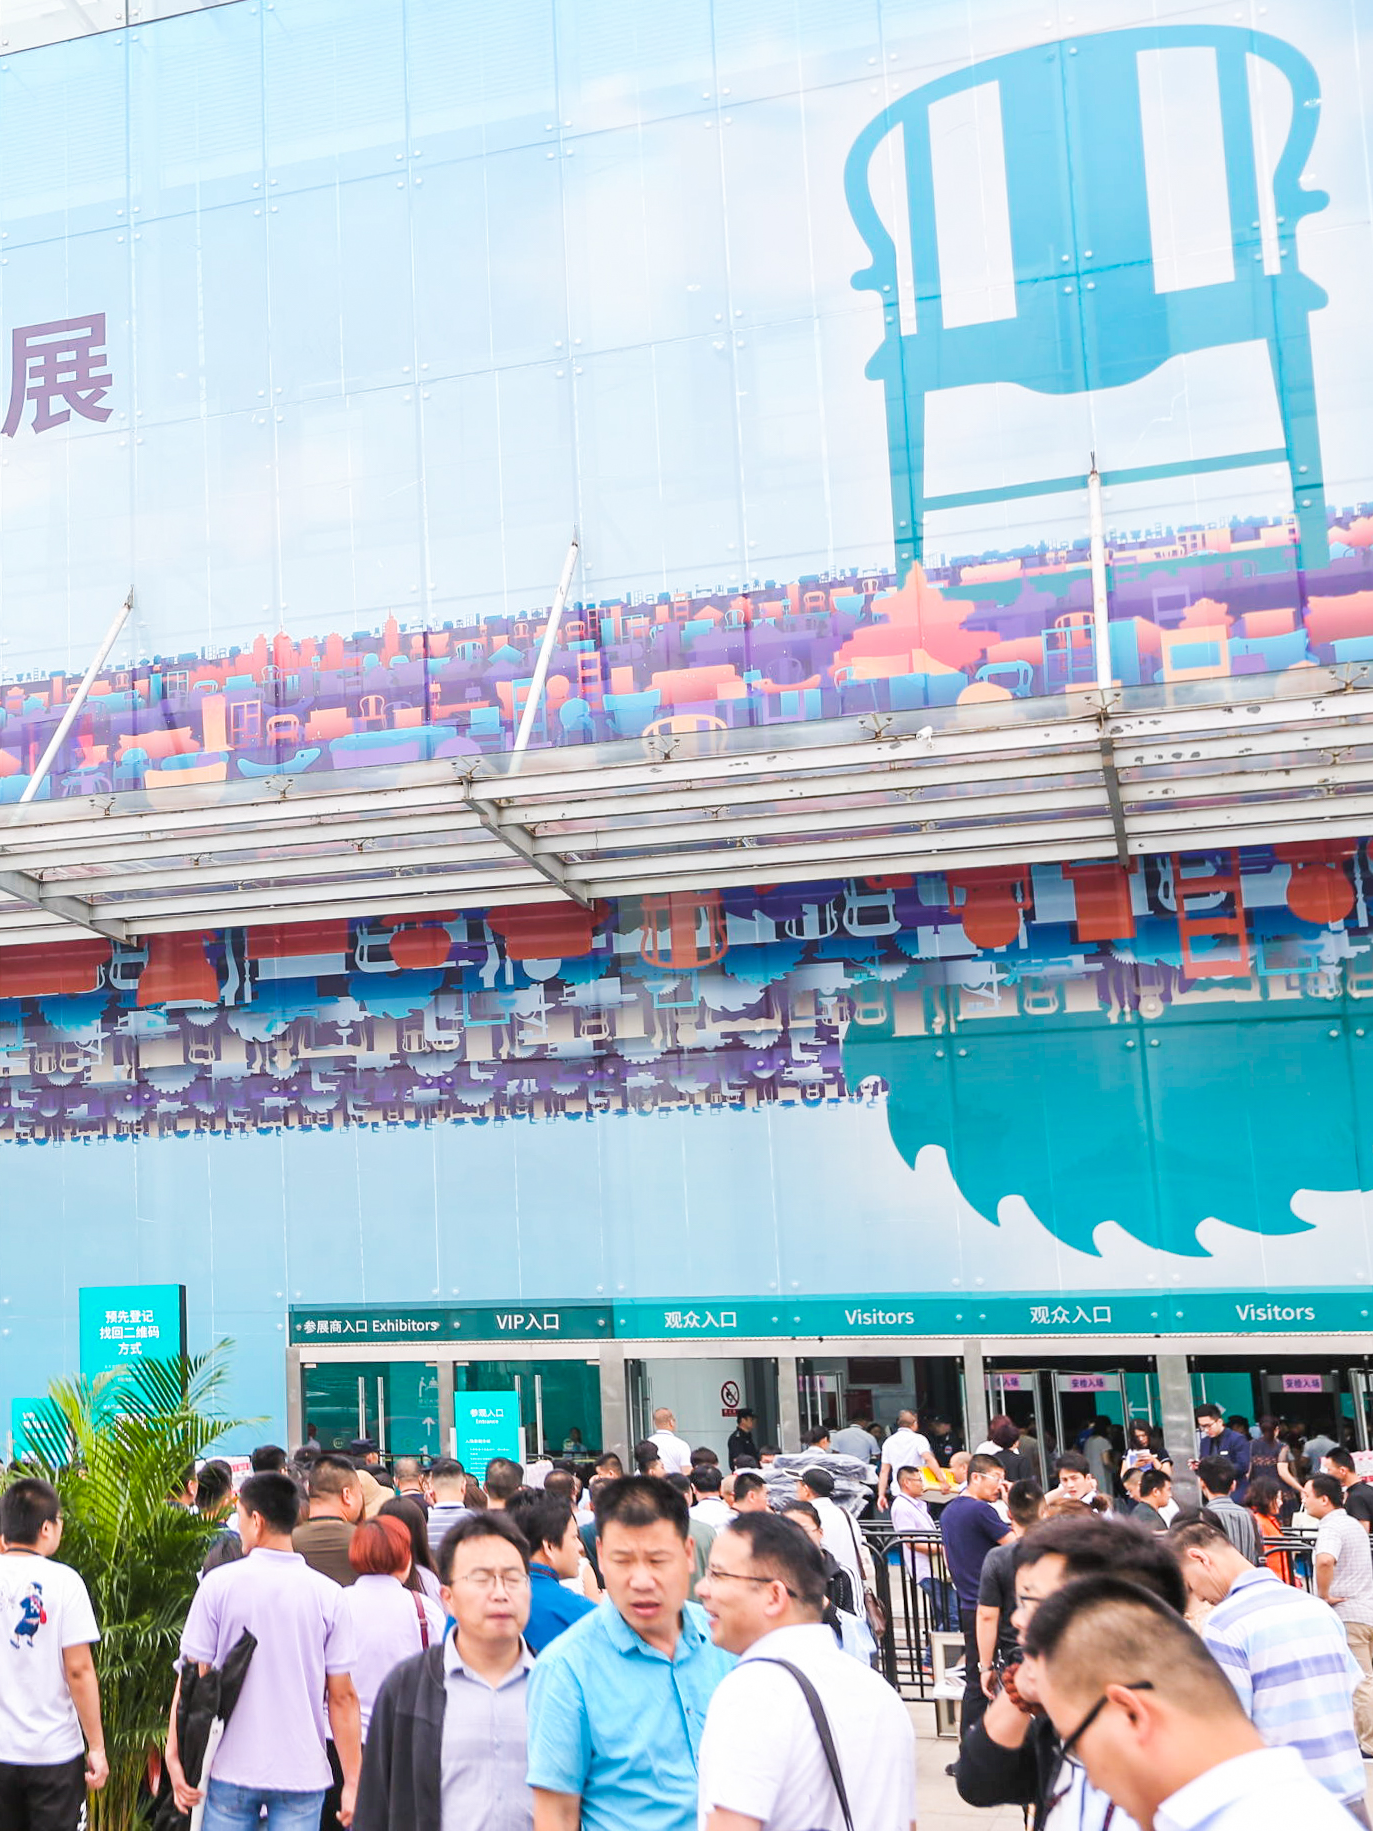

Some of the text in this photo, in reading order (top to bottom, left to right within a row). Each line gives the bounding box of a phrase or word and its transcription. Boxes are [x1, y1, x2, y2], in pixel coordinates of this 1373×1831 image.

[104, 1309, 154, 1323] 预先登记
[664, 1310, 737, 1329] 观众入口
[844, 1309, 915, 1325] Visitors
[1029, 1305, 1112, 1324] 观众入口
[1235, 1303, 1316, 1321] Visitors
[303, 1319, 438, 1334] 参展商入口 Exhibitors
[496, 1313, 559, 1331] VIP入口
[99, 1325, 160, 1339] 找回二维码
[118, 1341, 142, 1355] 方式
